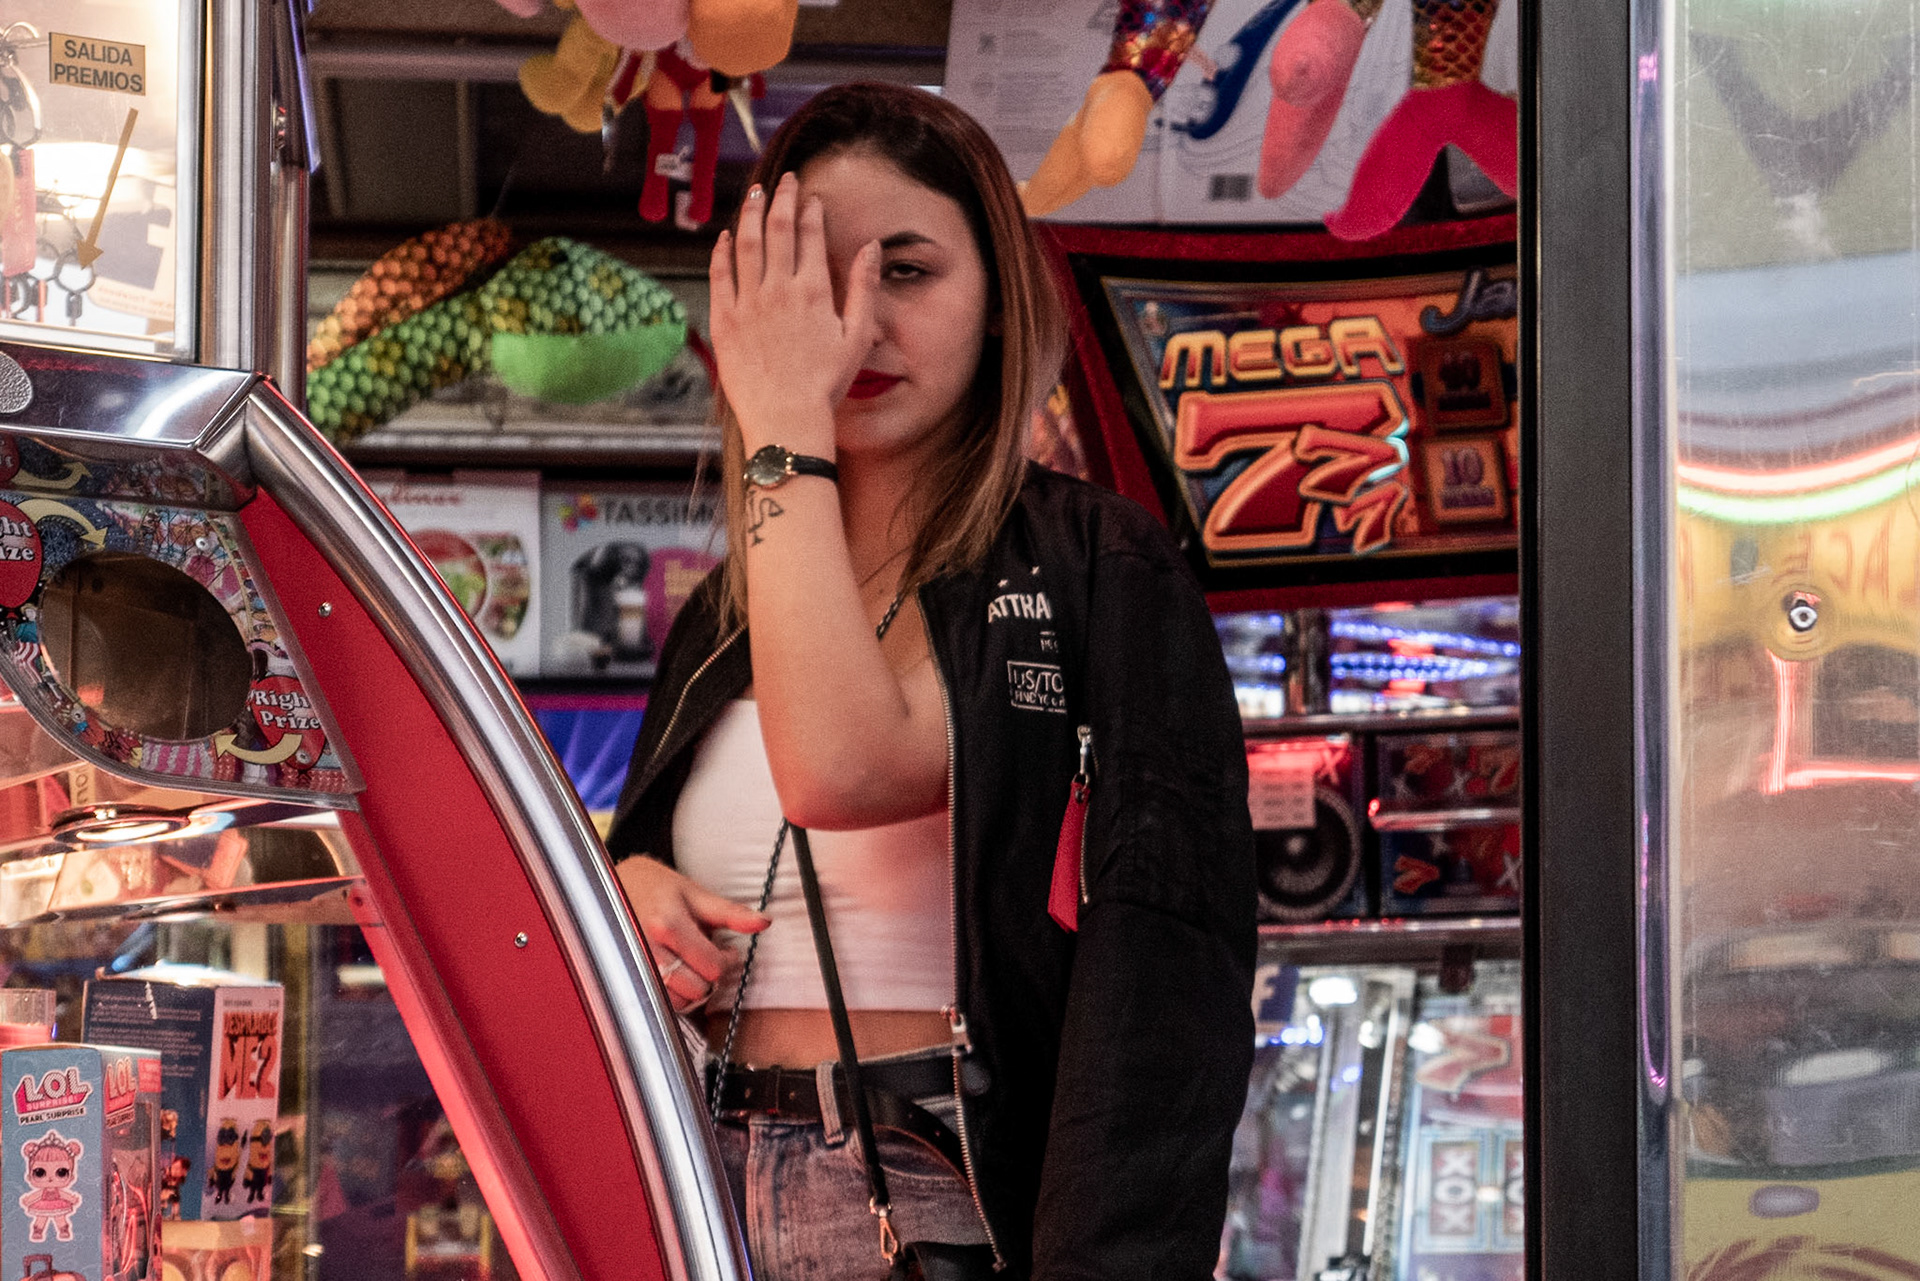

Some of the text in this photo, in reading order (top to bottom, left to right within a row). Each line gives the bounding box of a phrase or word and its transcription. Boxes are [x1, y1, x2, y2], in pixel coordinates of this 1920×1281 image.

[64, 40, 133, 66] SALIDA
[54, 63, 142, 92] PREMIOS
[1158, 315, 1405, 390] MEGA
[254, 690, 311, 711] Righ
[259, 710, 321, 730] Prize
[21, 1068, 89, 1103] LOL
[20, 1107, 84, 1124] PEARL SURPRISE
